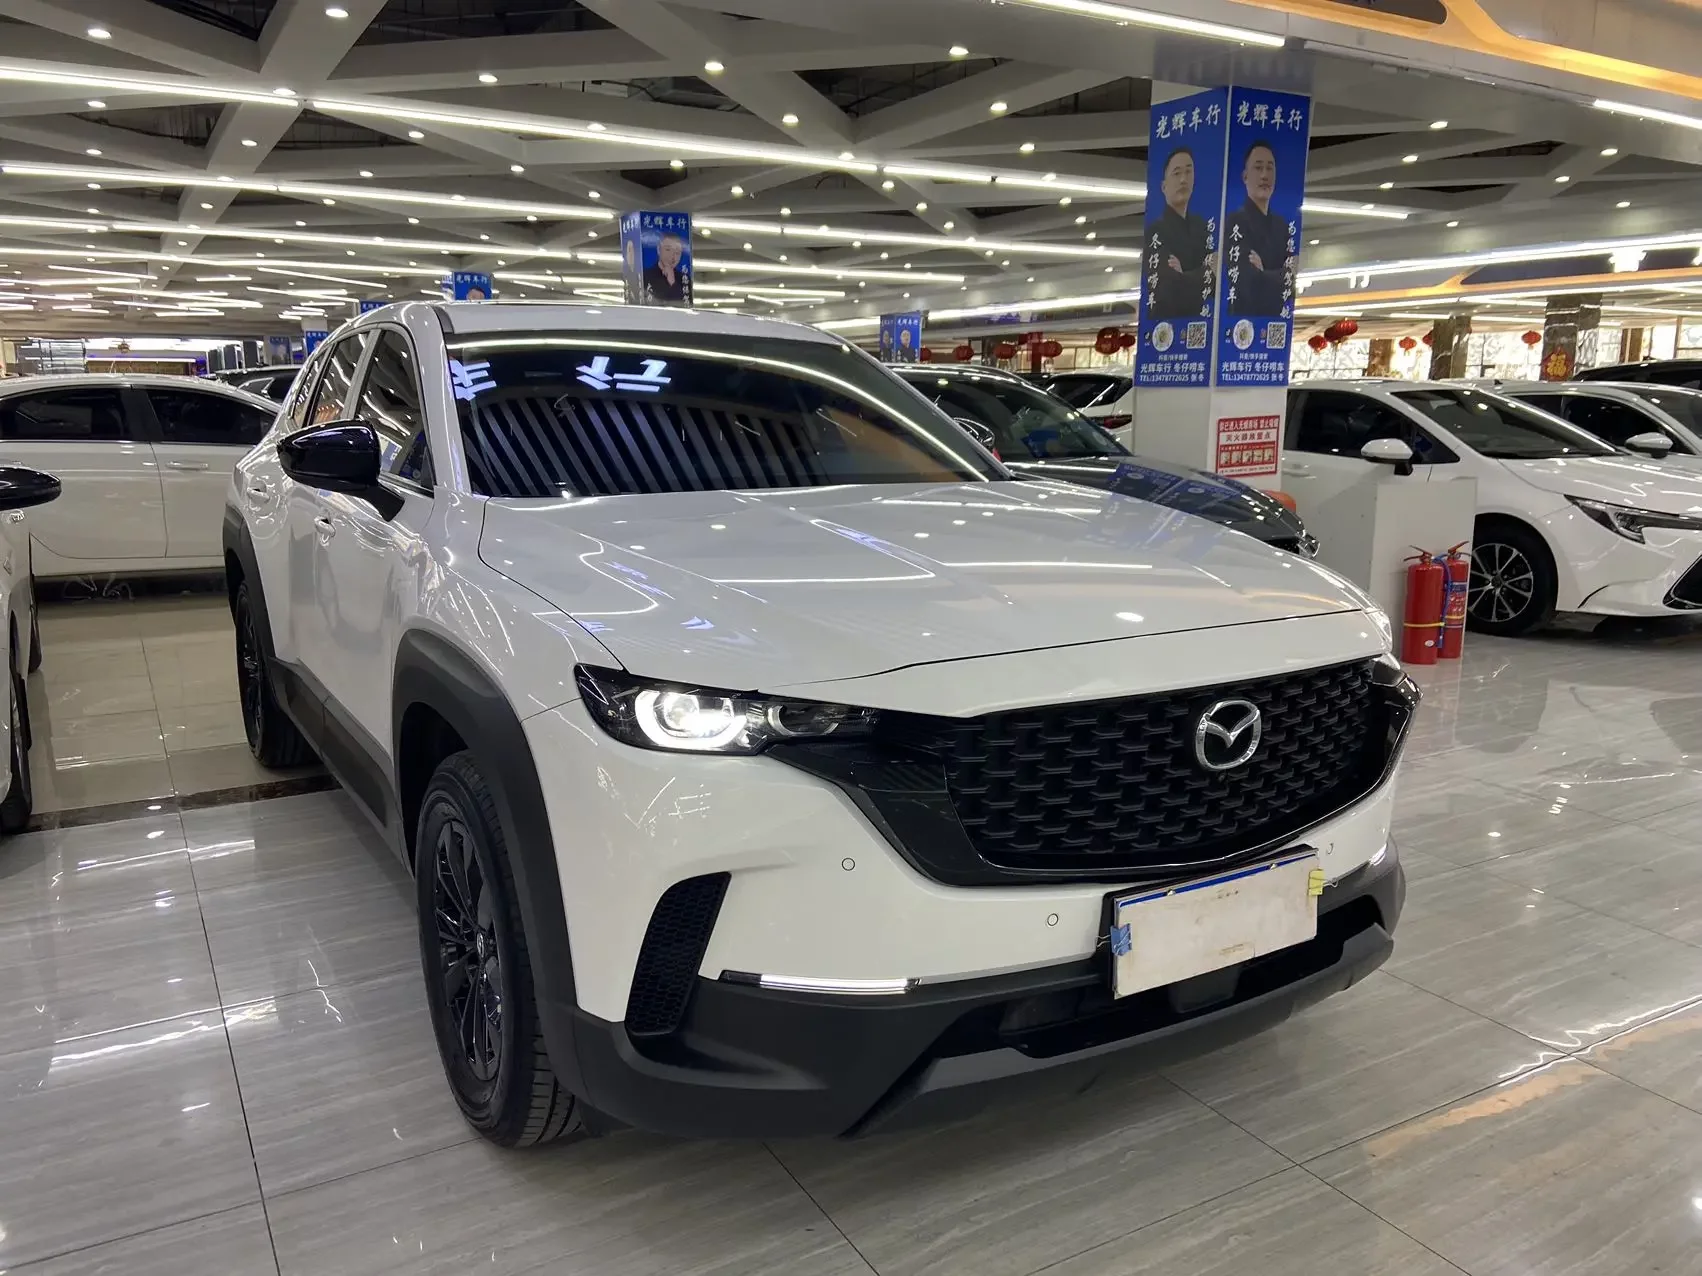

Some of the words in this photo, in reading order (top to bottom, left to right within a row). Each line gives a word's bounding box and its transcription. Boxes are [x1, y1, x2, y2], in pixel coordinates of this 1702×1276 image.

[1155, 103, 1222, 139] 光辉车行
[1236, 100, 1303, 132] 光辉车行
[1140, 362, 1171, 373] 光辉车行
[1222, 361, 1252, 373] 光辉车行
[1547, 354, 1567, 378] 福
